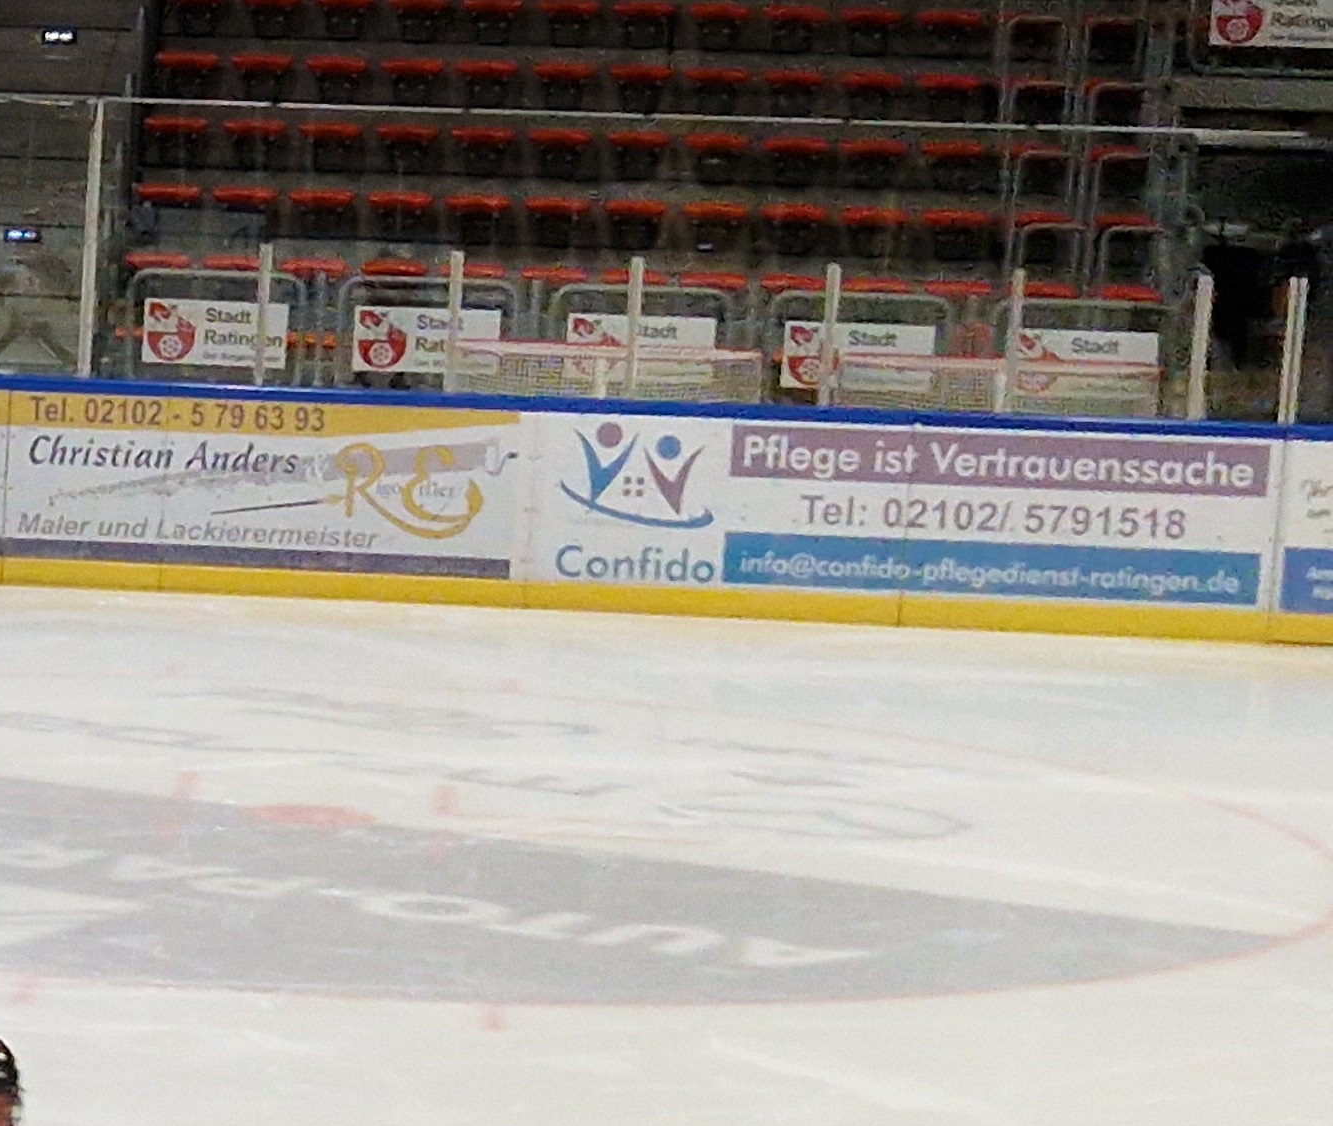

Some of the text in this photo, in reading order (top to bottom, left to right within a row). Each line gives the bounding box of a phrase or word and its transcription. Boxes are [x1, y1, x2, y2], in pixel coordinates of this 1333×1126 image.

[204, 306, 252, 324] Stadt
[847, 329, 897, 347] Stadt
[1070, 336, 1119, 355] Stadt
[29, 395, 75, 423] Tel.
[84, 398, 163, 426] 02102
[191, 402, 204, 428] 5
[214, 404, 245, 430] 79
[254, 404, 286, 431] 63
[294, 405, 326, 432] 93
[28, 434, 300, 475] Christian Anders
[741, 434, 1256, 489] Pflege ist Vertrauenssache
[17, 512, 380, 550] Maler und Lackierermeister
[801, 493, 1188, 540] Tel: 02102/ 5791518
[554, 544, 716, 584] Confido
[740, 549, 1240, 597] info@confido-pflegedienst-ratingen.de
